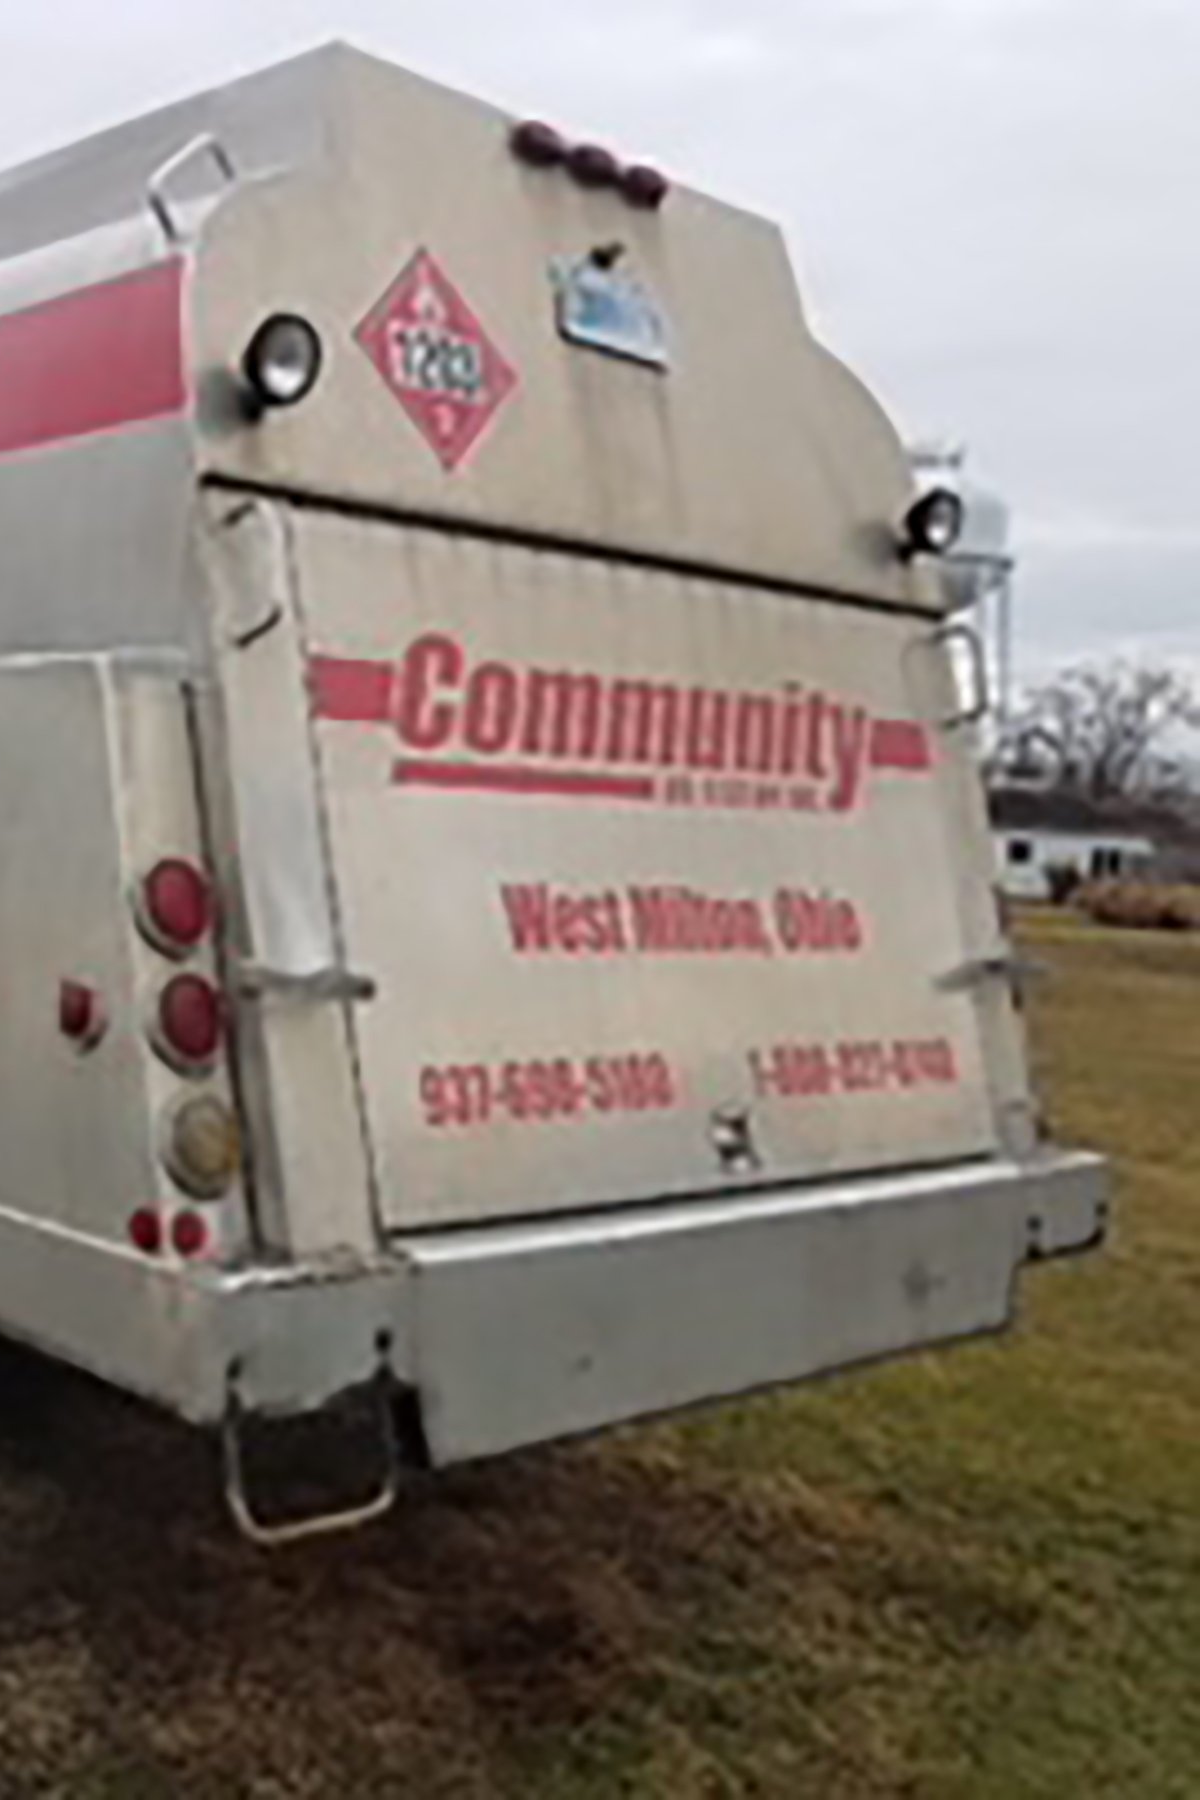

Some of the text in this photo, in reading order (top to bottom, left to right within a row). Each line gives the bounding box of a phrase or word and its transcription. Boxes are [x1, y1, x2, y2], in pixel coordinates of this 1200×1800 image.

[394, 327, 482, 396] 1203
[396, 634, 867, 812] Community
[501, 884, 862, 955] West Milton, Ohio
